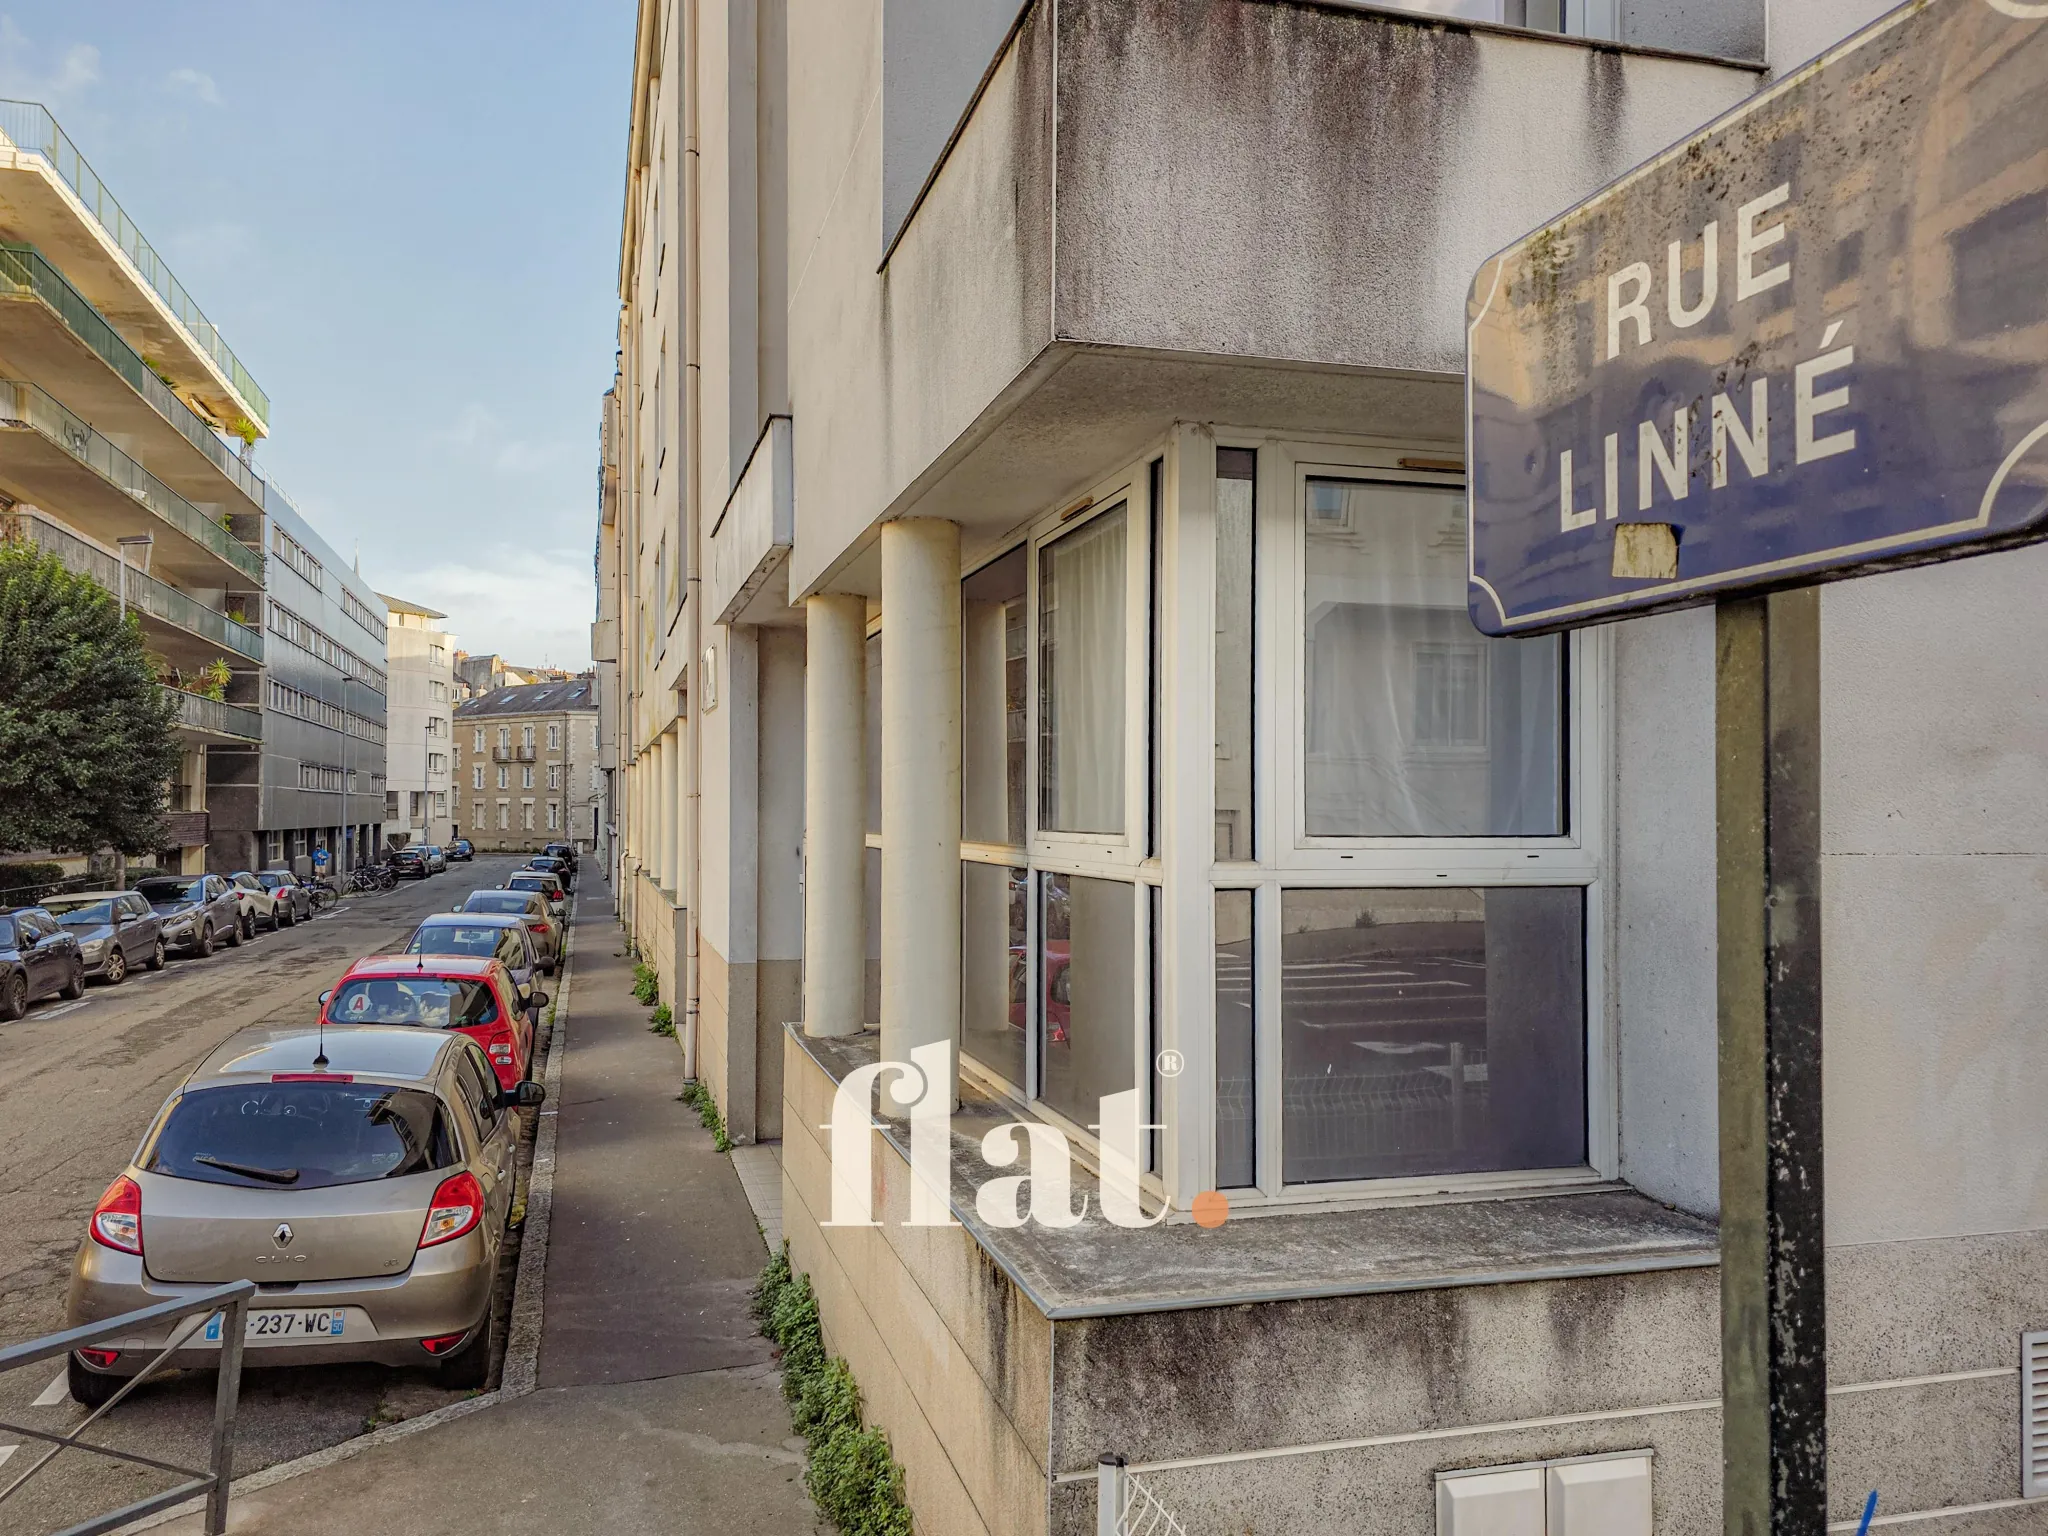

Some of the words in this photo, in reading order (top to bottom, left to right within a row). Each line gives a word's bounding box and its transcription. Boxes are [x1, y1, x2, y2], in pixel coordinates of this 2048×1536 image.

[1607, 182, 1791, 360] RUE
[1560, 320, 1856, 532] LINNÉ
[352, 996, 365, 1011] A
[255, 1254, 307, 1264] CLIO
[244, 1312, 330, 1335] -237-WC
